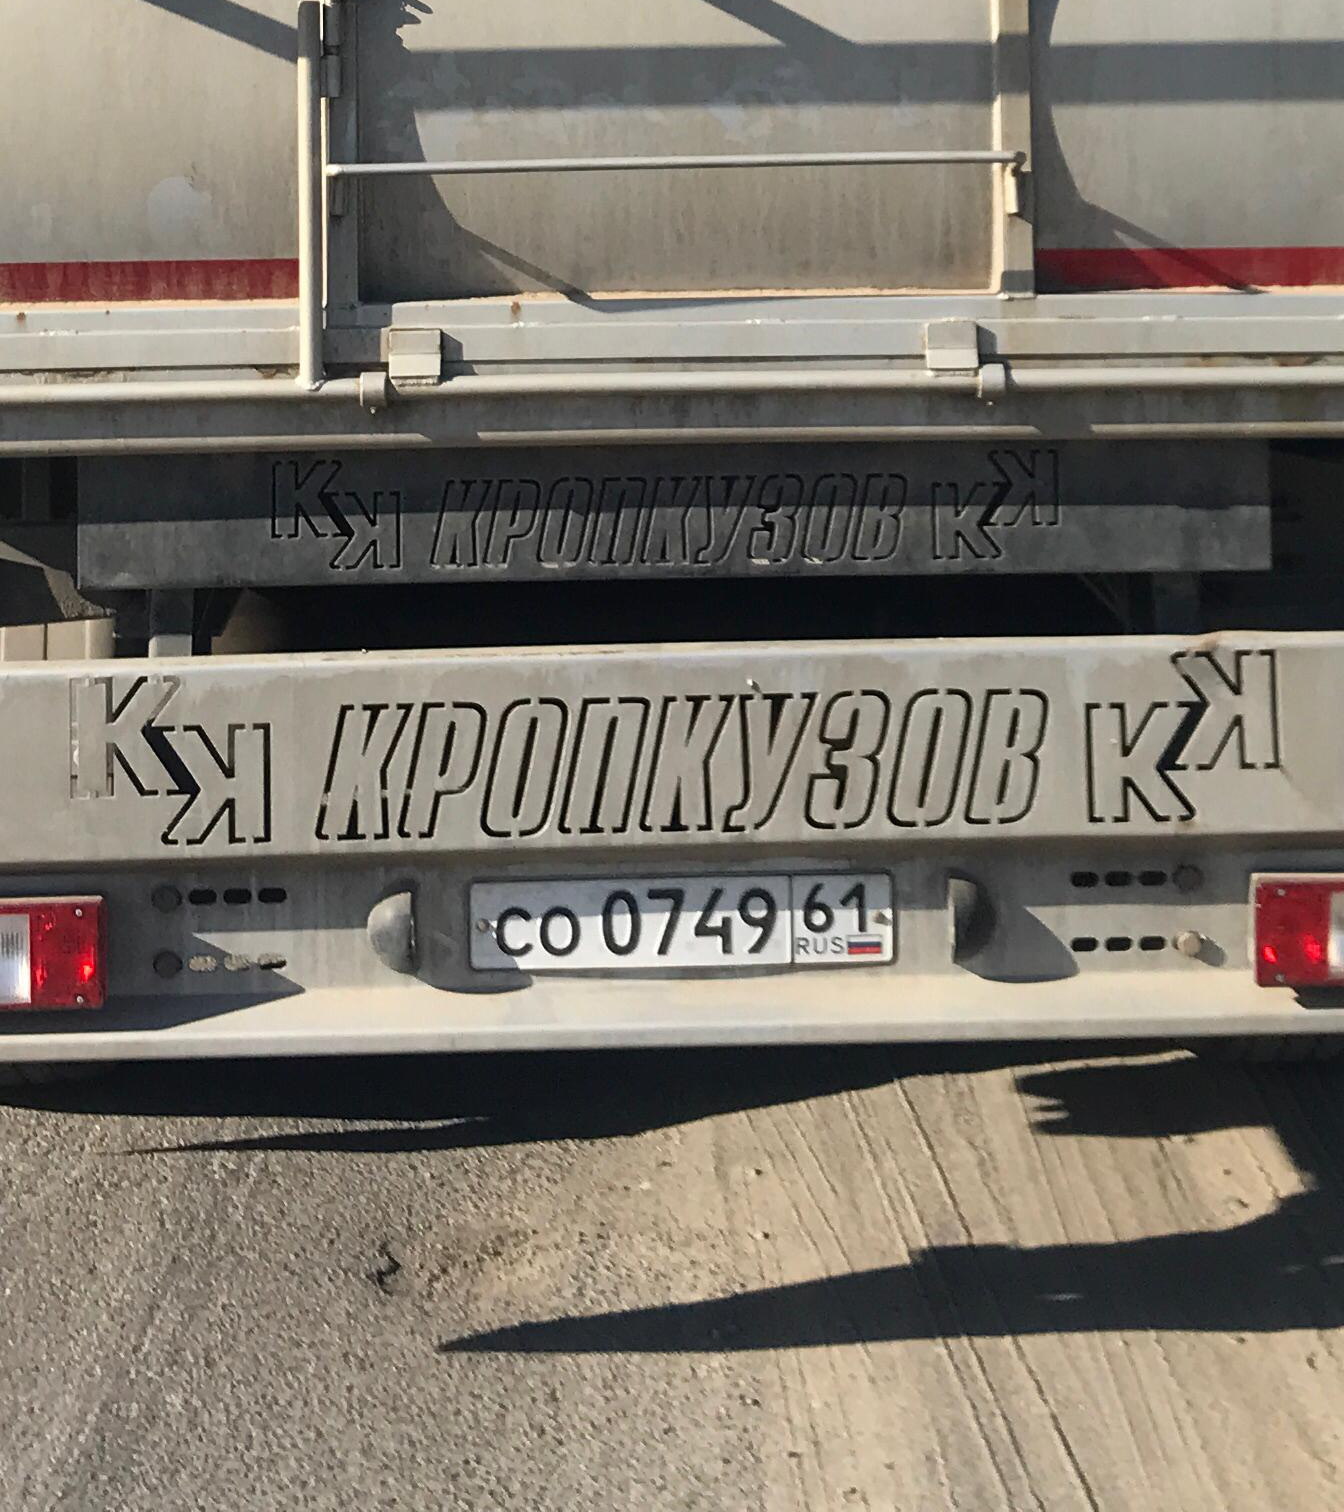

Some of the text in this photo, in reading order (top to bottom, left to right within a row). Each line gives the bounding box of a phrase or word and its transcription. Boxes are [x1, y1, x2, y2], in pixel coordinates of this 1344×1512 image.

[429, 473, 909, 569] КРОПКУЗОВ
[314, 687, 1050, 841] КРОПКУЗОВ
[601, 886, 778, 957] 0749
[801, 881, 868, 934] 61
[795, 936, 845, 956] RUS
